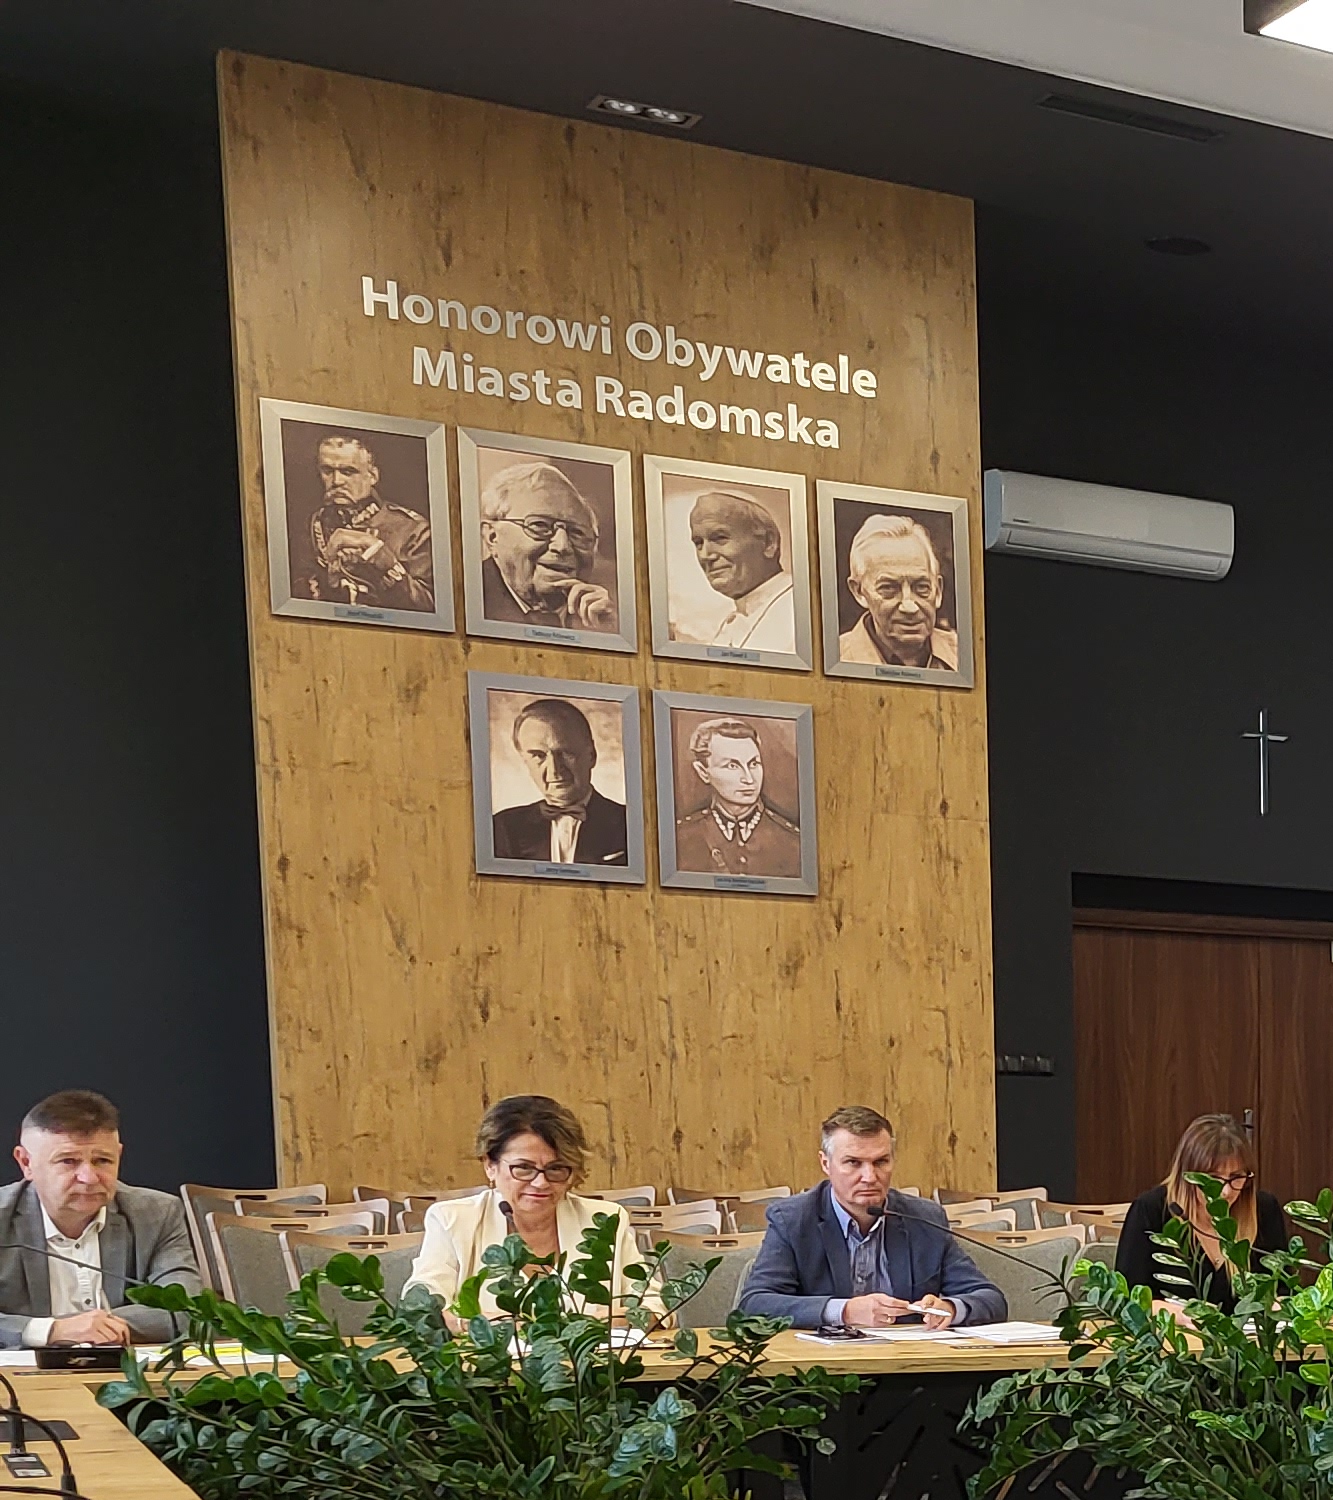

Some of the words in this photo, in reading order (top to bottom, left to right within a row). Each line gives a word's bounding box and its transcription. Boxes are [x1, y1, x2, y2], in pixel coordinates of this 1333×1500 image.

[361, 276, 612, 356] Honorowi
[625, 321, 878, 399] Obywatele
[412, 346, 583, 410] Miasta
[594, 376, 841, 450] Radomska
